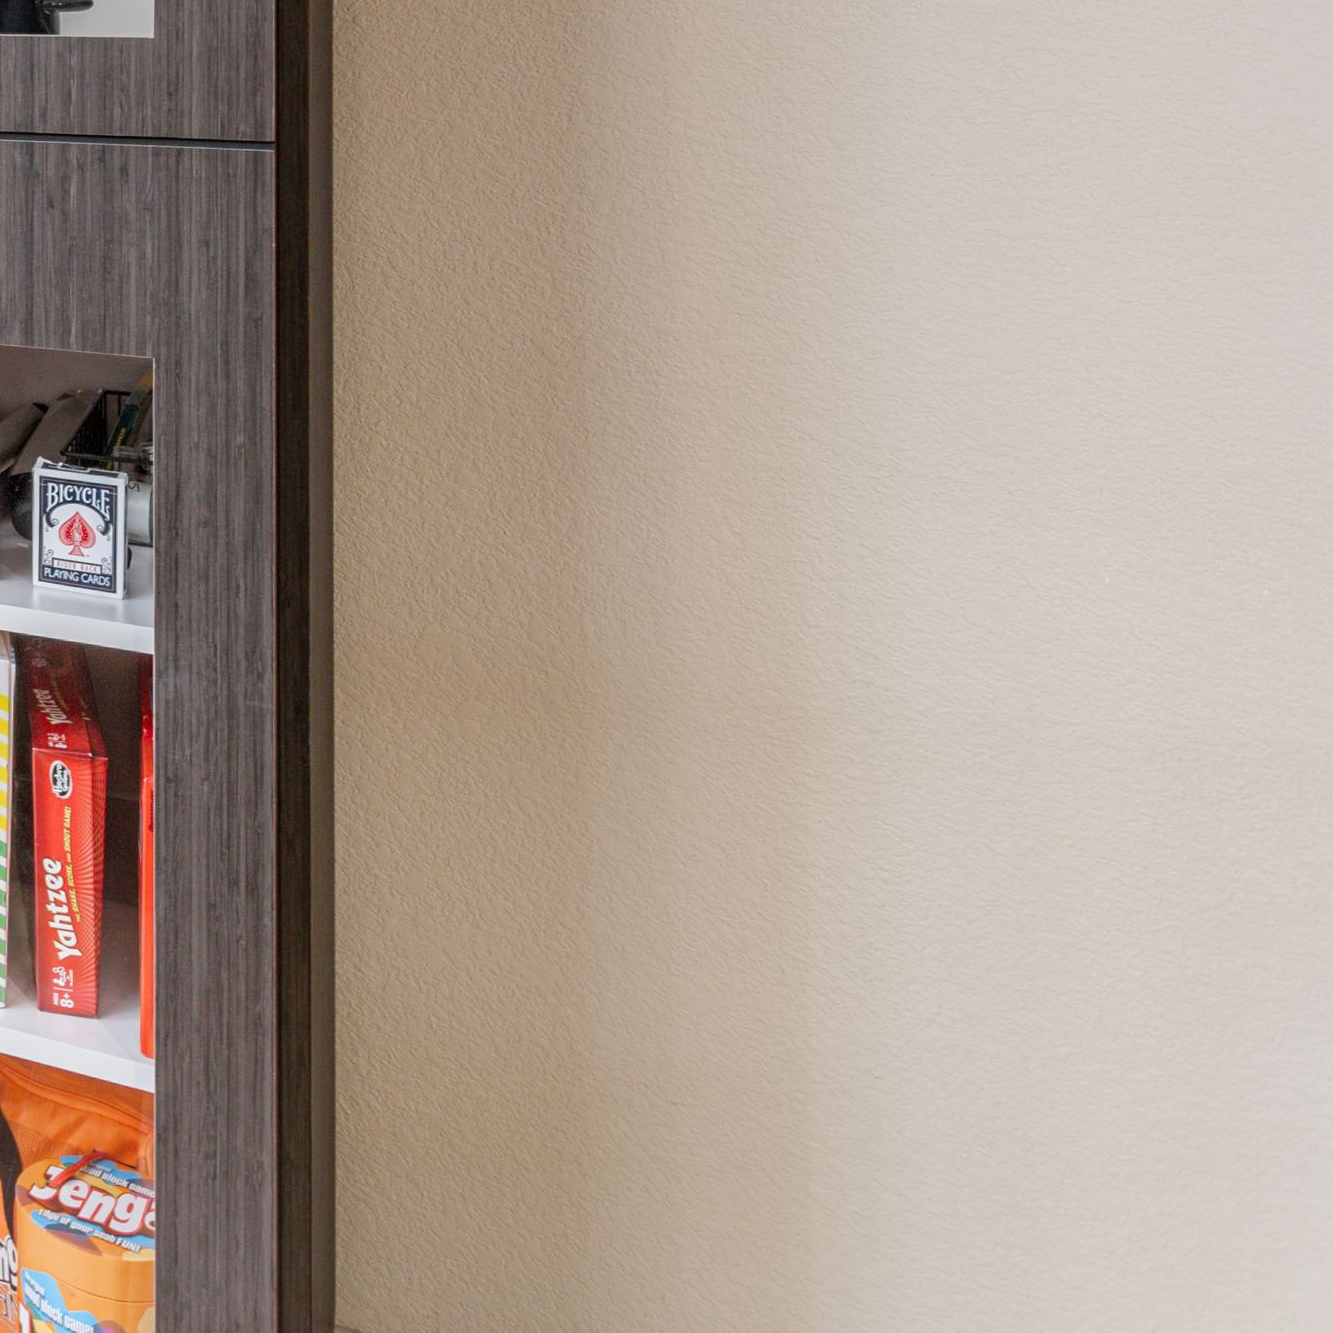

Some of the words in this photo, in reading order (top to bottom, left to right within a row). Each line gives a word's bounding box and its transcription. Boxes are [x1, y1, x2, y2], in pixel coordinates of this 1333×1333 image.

[46, 482, 110, 522] BICYCLE
[44, 567, 79, 582] PLAYING
[81, 573, 111, 586] CARDS
[63, 806, 72, 827] GAME!
[63, 827, 72, 854] SHOUT
[65, 864, 75, 887] SCORE,
[42, 857, 83, 961] Yahtzee
[70, 889, 80, 913] SHAKE,
[60, 993, 74, 1008] 8+
[61, 1213, 70, 1224] of
[69, 1218, 93, 1234] your
[116, 1236, 141, 1254] FUN!
[41, 1298, 63, 1326] block
